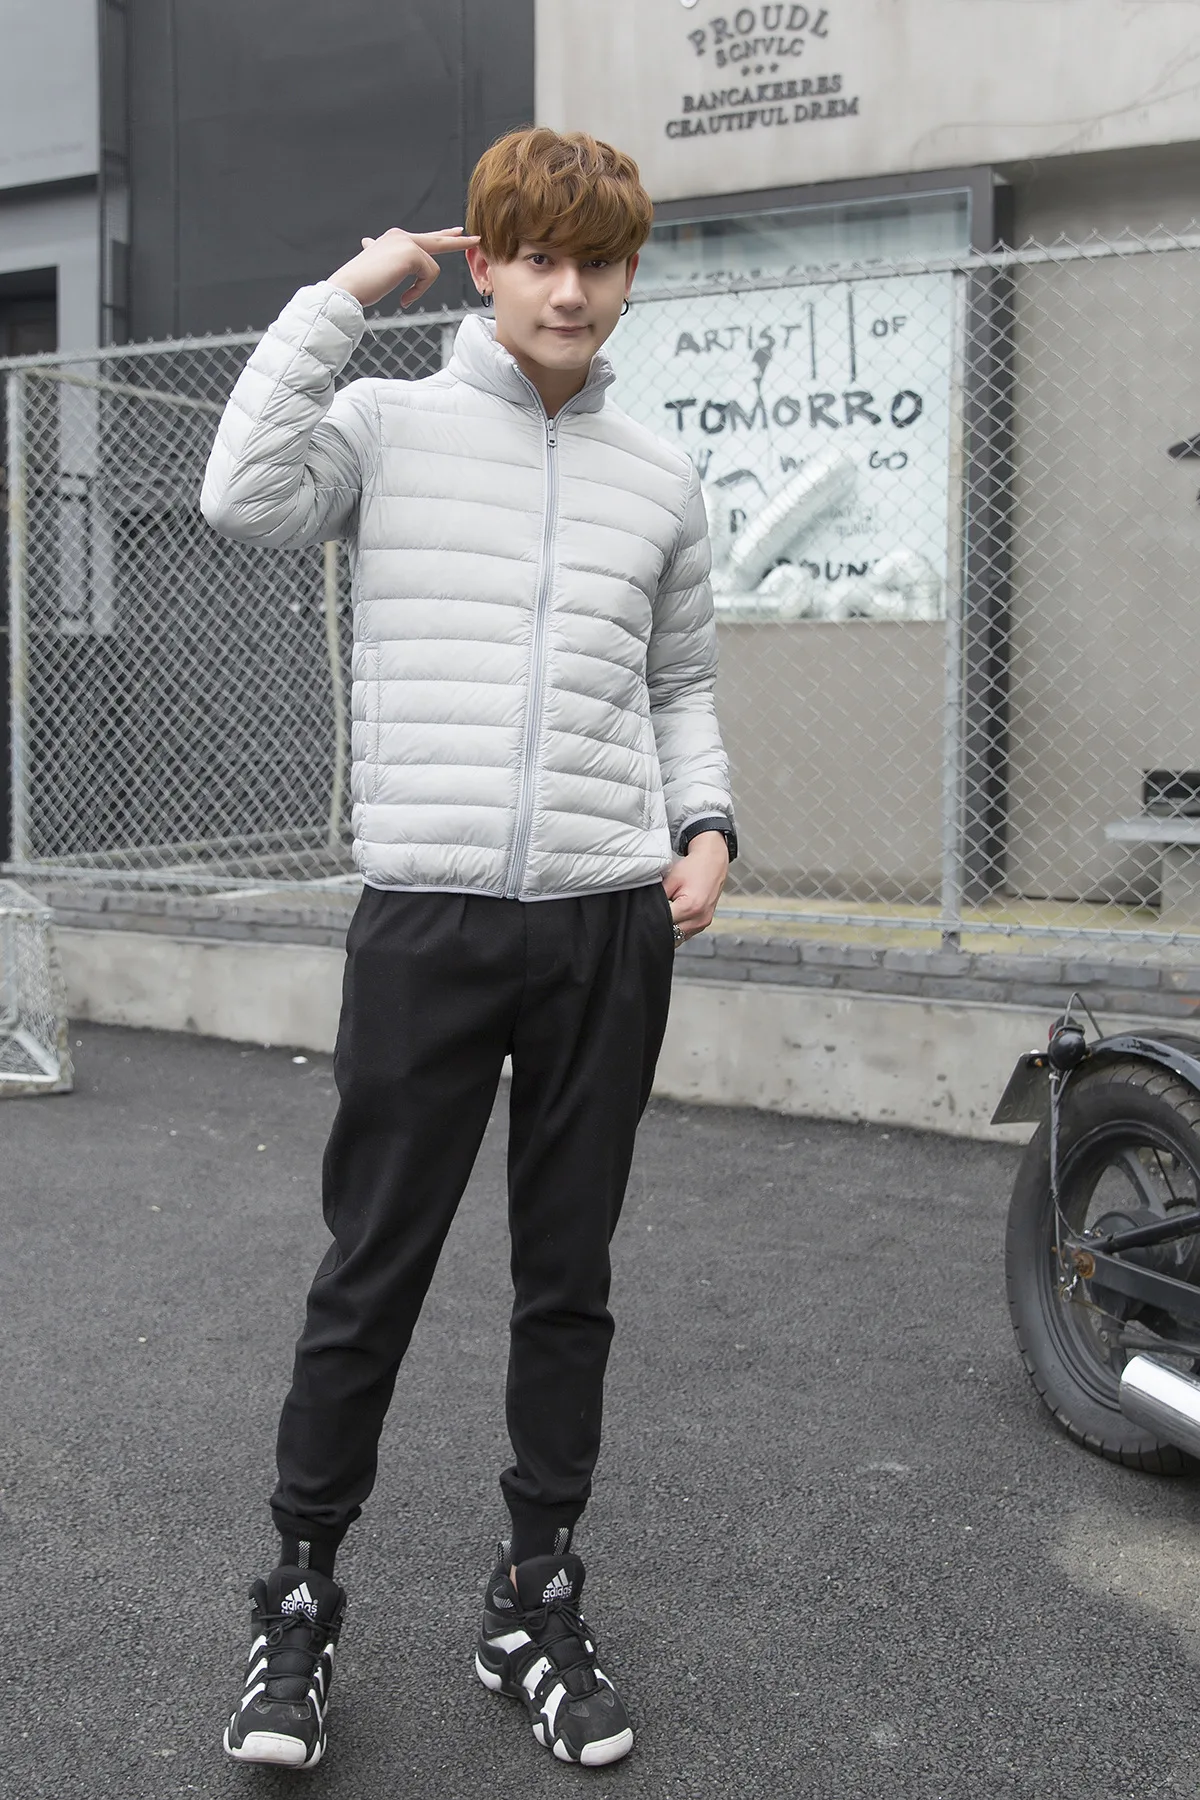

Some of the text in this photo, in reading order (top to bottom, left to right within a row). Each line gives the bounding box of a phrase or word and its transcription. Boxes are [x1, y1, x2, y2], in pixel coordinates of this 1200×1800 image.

[687, 4, 829, 56] PROUDL
[676, 316, 907, 356] ARTIST OF
[665, 390, 923, 434] TOMORRO
[281, 1600, 318, 1613] adidas
[543, 1586, 572, 1599] adidas
